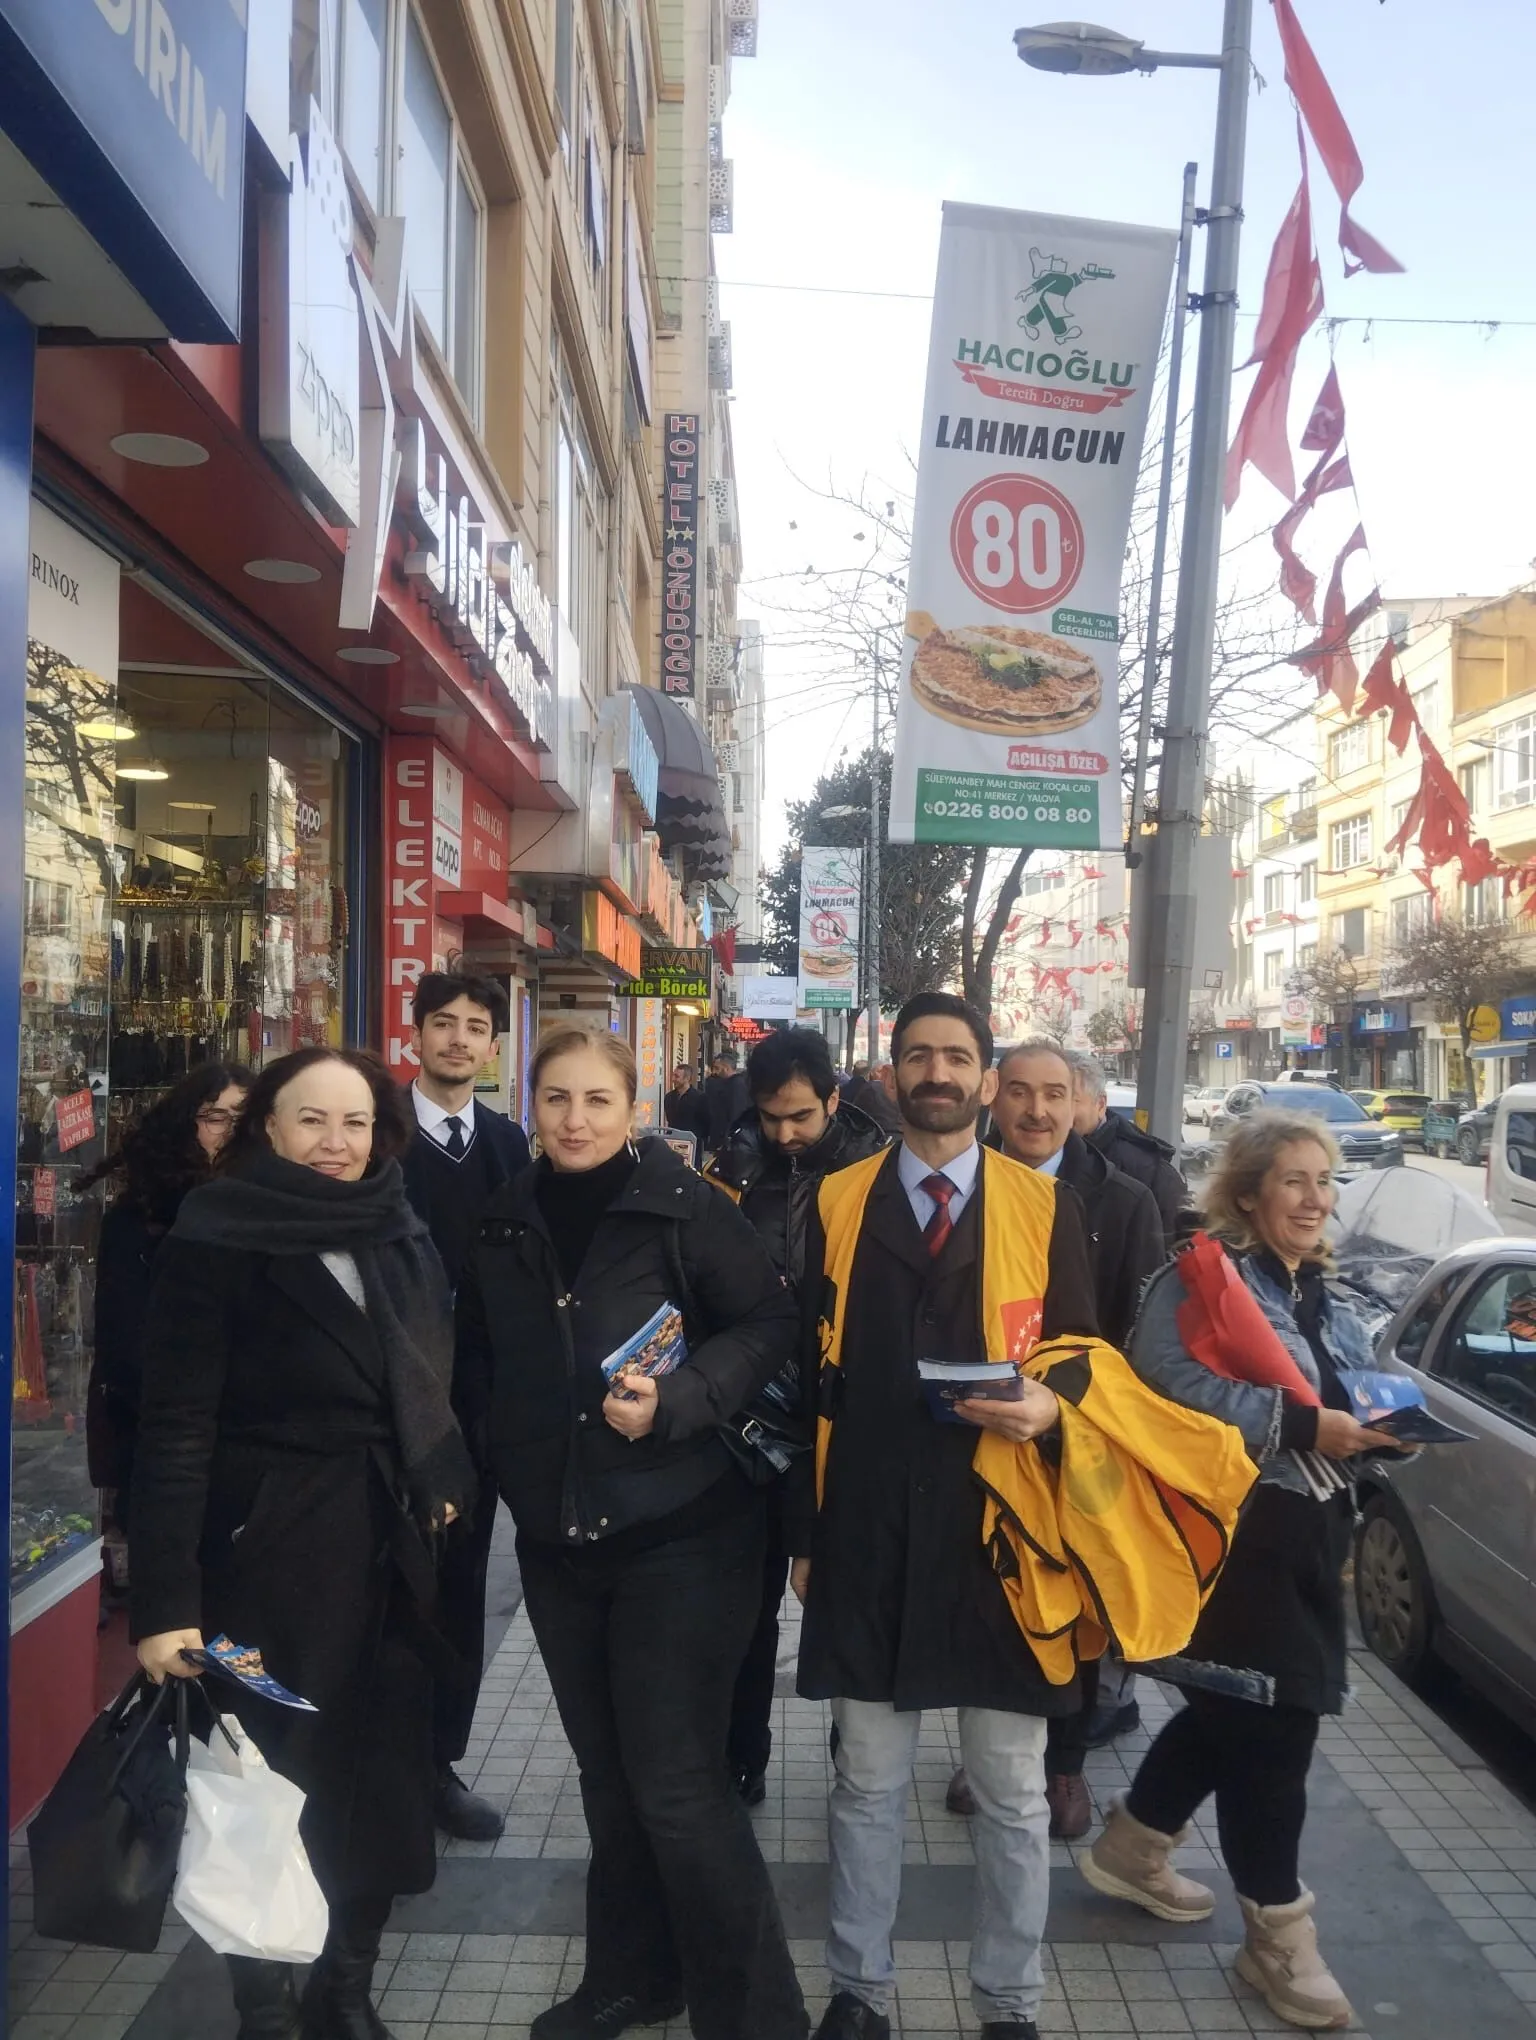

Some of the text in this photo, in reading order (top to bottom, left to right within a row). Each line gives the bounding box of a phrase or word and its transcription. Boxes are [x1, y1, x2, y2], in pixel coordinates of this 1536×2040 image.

[998, 382, 1085, 409] Tercih Doğru
[936, 415, 1126, 465] LAHMACUN
[669, 416, 696, 522] HOTEL
[971, 500, 1062, 590] 80
[1069, 752, 1100, 771] ÖZEL
[984, 791, 1017, 802] MERKEZ
[1027, 794, 1061, 803] YALOVA
[986, 779, 1007, 789] MAH
[1072, 784, 1091, 793] CAD
[934, 800, 1092, 823] 0226 800 08 80
[660, 979, 708, 996] Börek
